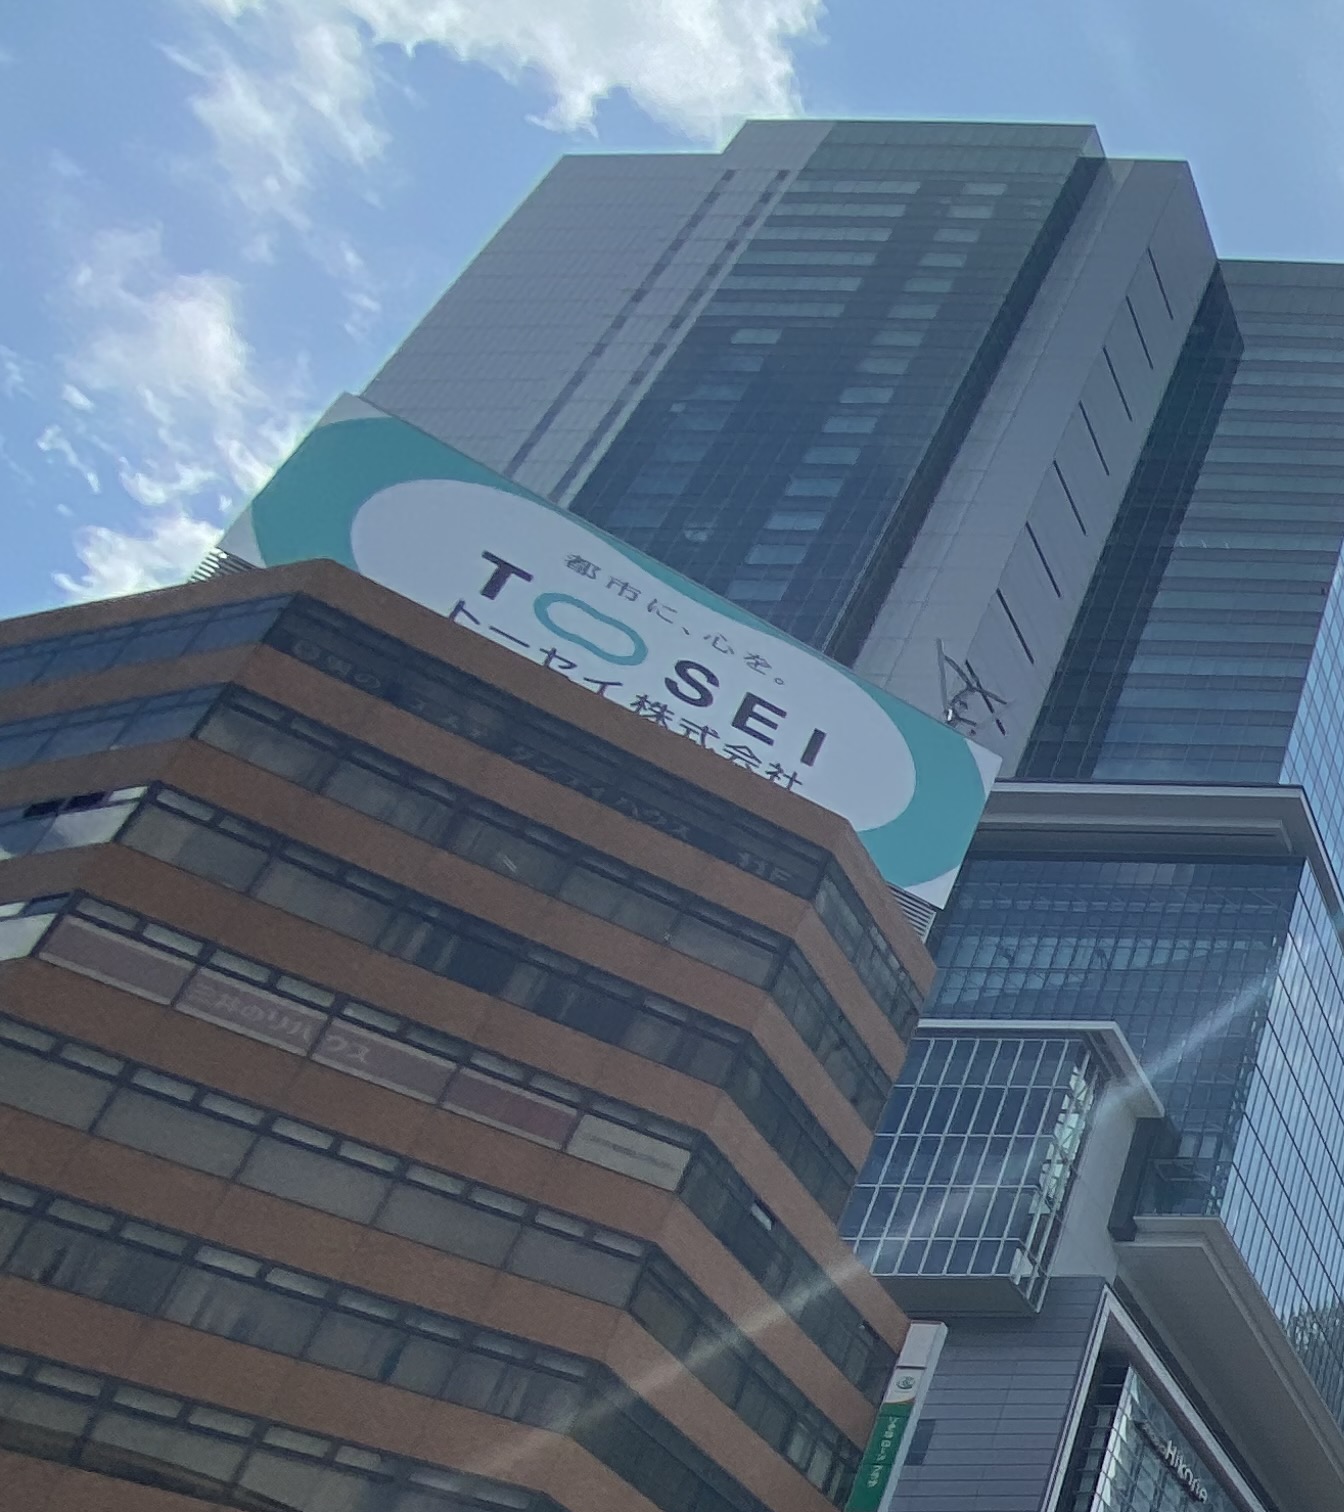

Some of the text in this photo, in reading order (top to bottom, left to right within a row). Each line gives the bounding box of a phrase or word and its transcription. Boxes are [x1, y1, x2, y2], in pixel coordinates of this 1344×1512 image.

[480, 550, 827, 767] TOSEI
[563, 553, 785, 686] 都市に、心を。
